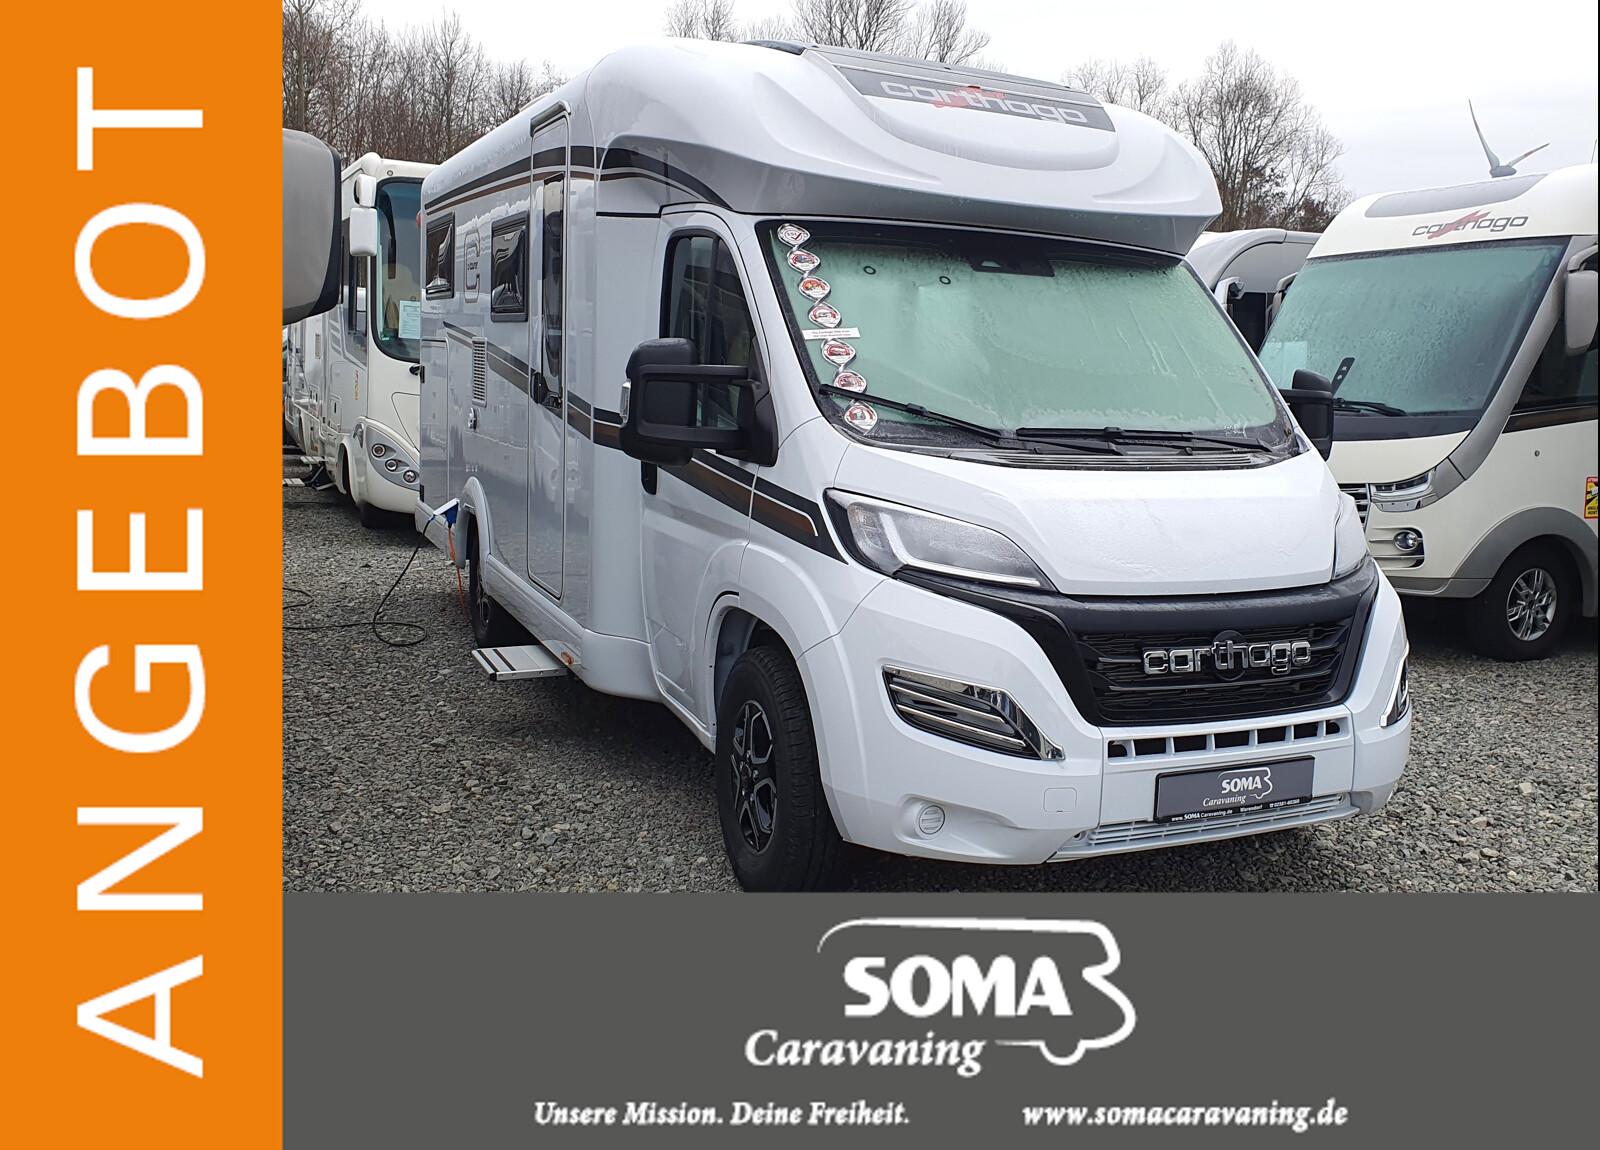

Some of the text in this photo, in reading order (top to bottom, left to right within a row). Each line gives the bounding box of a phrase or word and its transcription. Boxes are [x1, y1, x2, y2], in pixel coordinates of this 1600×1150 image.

[880, 80, 1089, 124] carthago
[1143, 640, 1311, 676] carthago
[1221, 775, 1263, 794] SOMA
[1202, 794, 1247, 807] Caravaning
